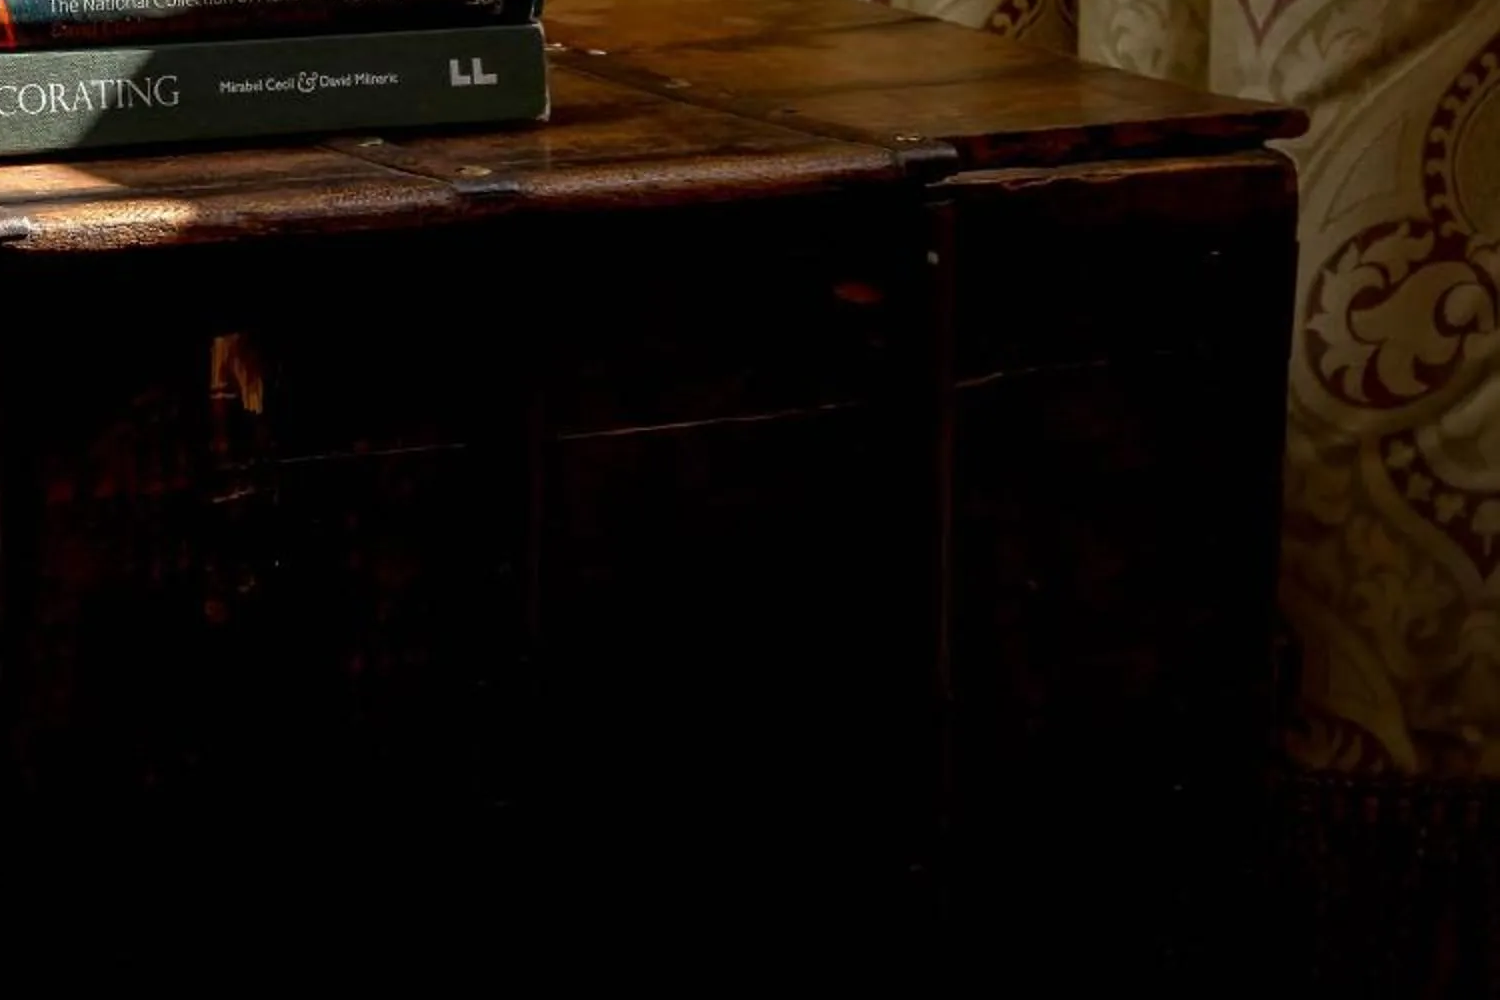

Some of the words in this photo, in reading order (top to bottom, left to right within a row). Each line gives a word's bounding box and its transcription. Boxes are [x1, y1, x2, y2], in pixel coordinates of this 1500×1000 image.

[218, 78, 263, 93] Mirabel
[265, 77, 296, 91] Cecil
[319, 73, 353, 88] David
